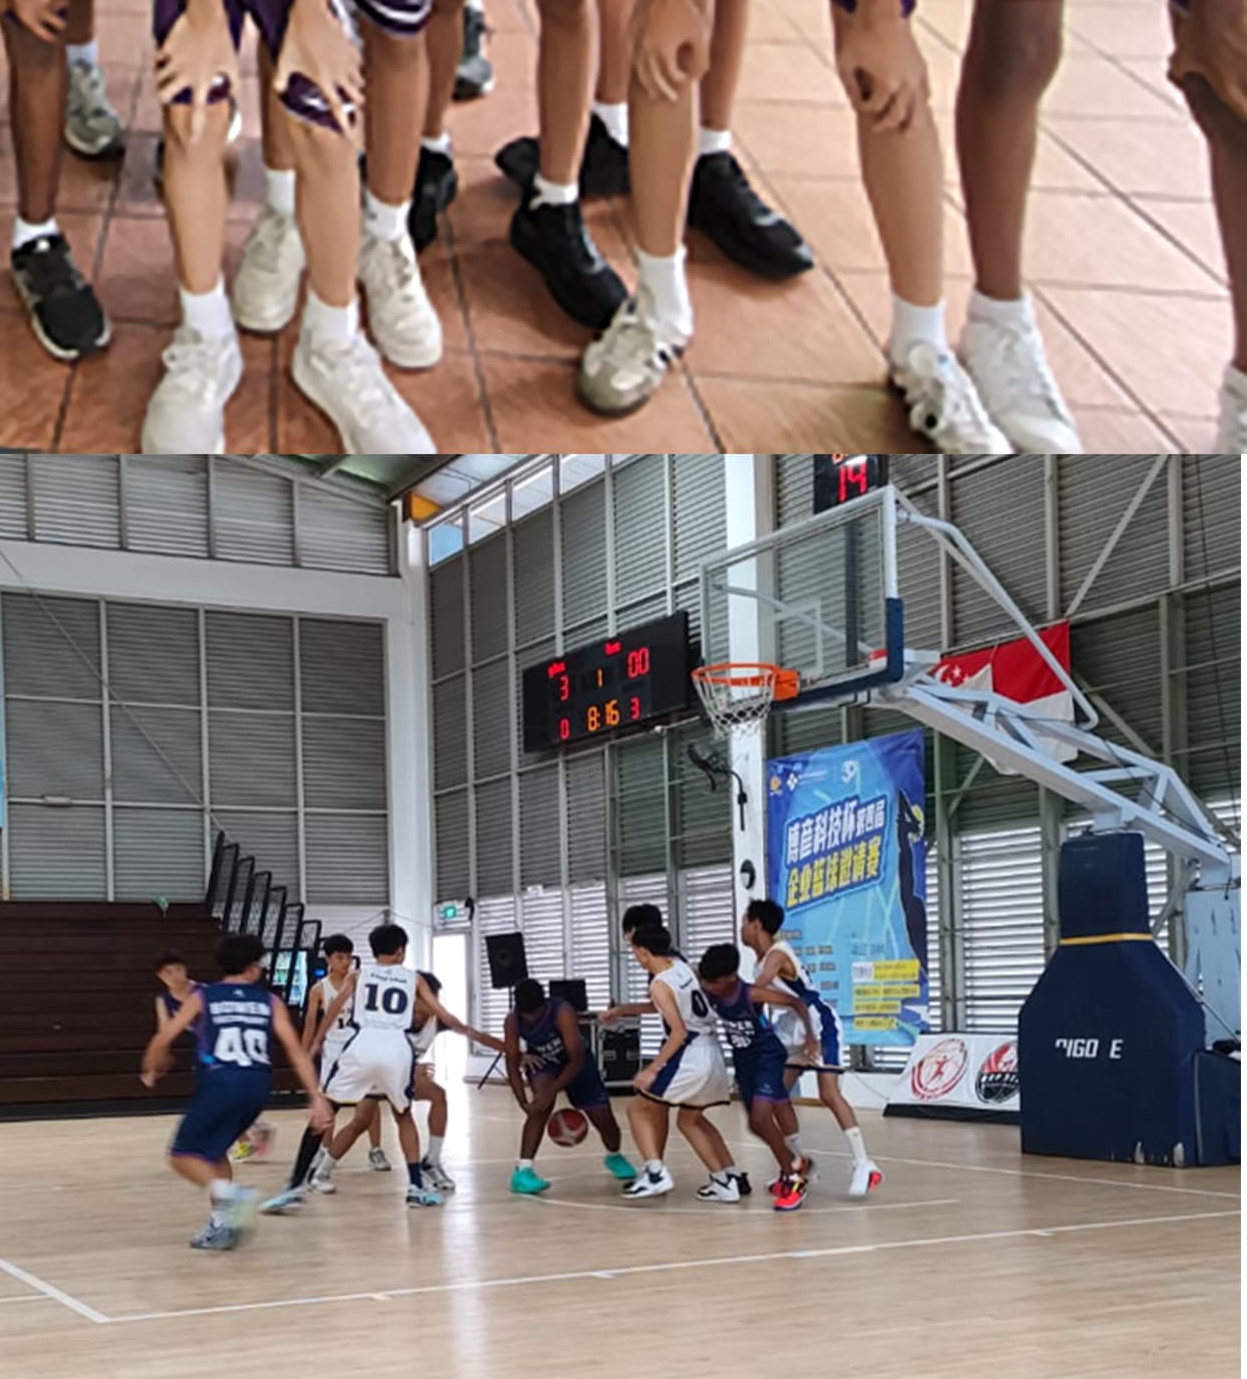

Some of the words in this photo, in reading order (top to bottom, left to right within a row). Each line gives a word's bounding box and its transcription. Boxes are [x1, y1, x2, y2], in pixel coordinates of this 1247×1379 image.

[627, 647, 649, 679] 00
[559, 675, 570, 700] 3
[630, 697, 640, 719] 3
[559, 719, 571, 739] 0
[365, 984, 408, 1014] 10
